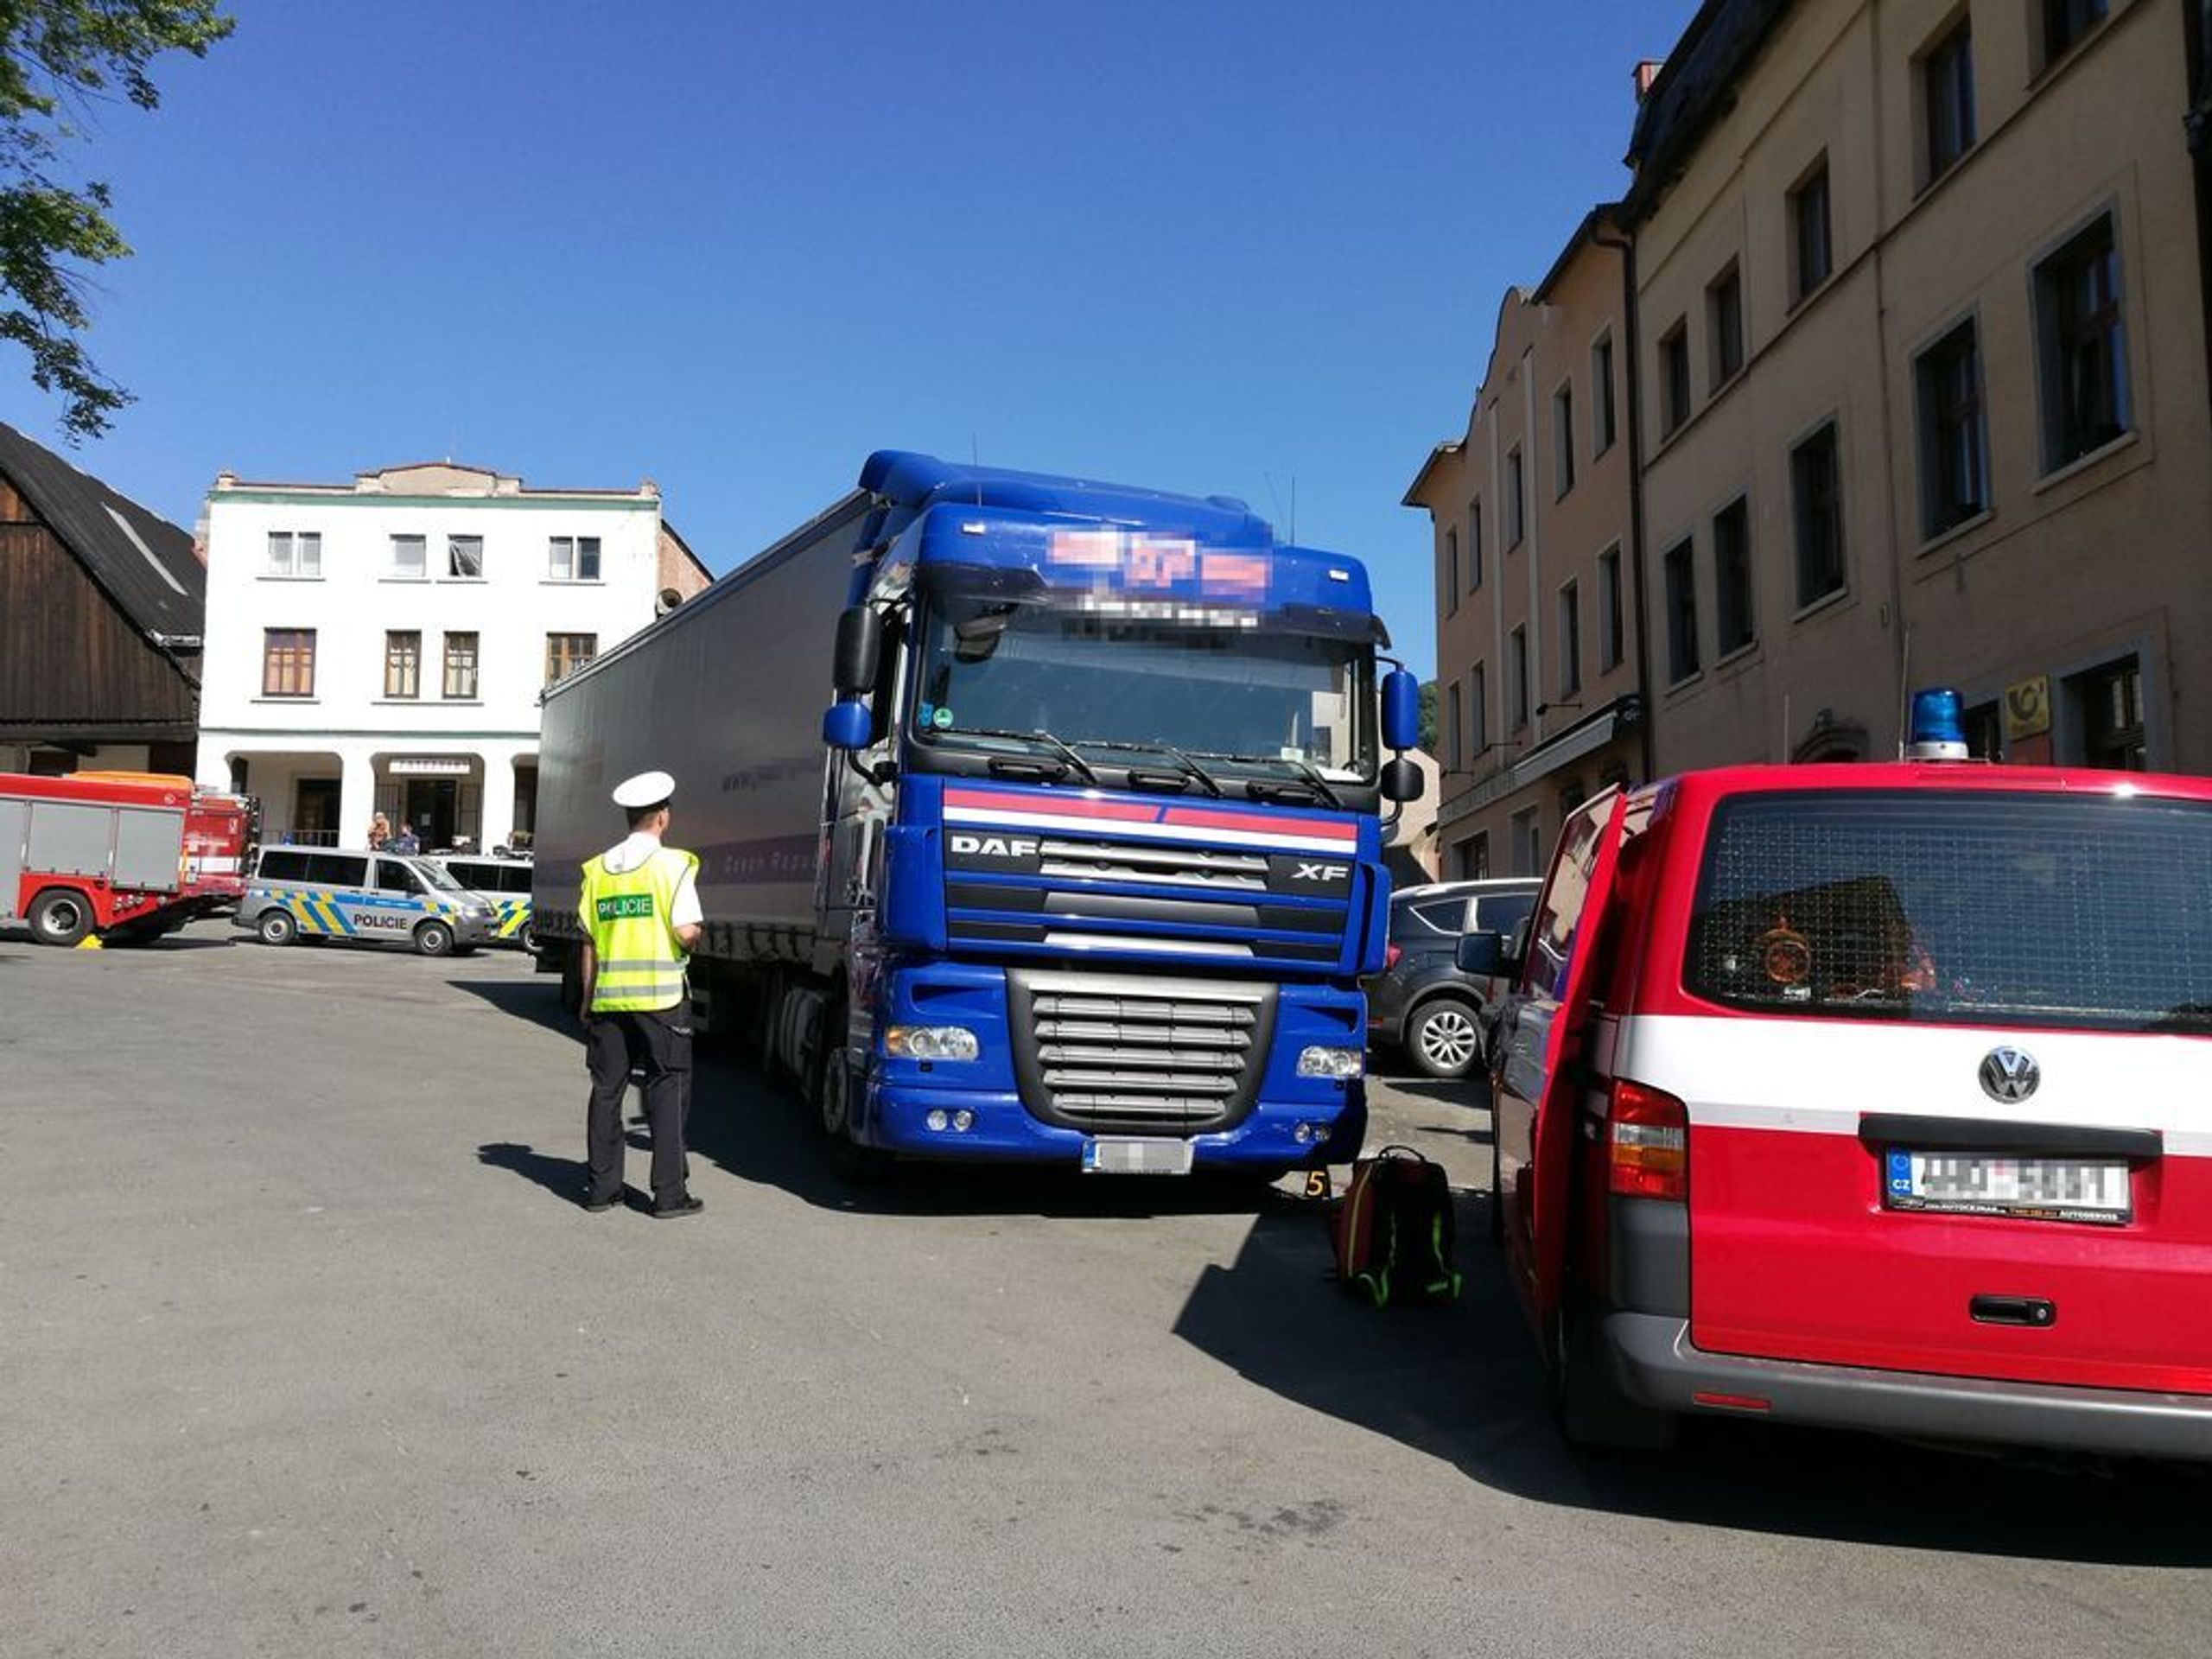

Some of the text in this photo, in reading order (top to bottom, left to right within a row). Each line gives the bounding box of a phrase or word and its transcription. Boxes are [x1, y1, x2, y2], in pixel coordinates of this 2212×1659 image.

[951, 836, 1037, 857] DAF
[1292, 862, 1349, 881] XF
[598, 898, 652, 917] POLICIE
[353, 913, 408, 930] POLICIE
[1307, 1171, 1325, 1196] 5
[1892, 1179, 1910, 1191] CZ
